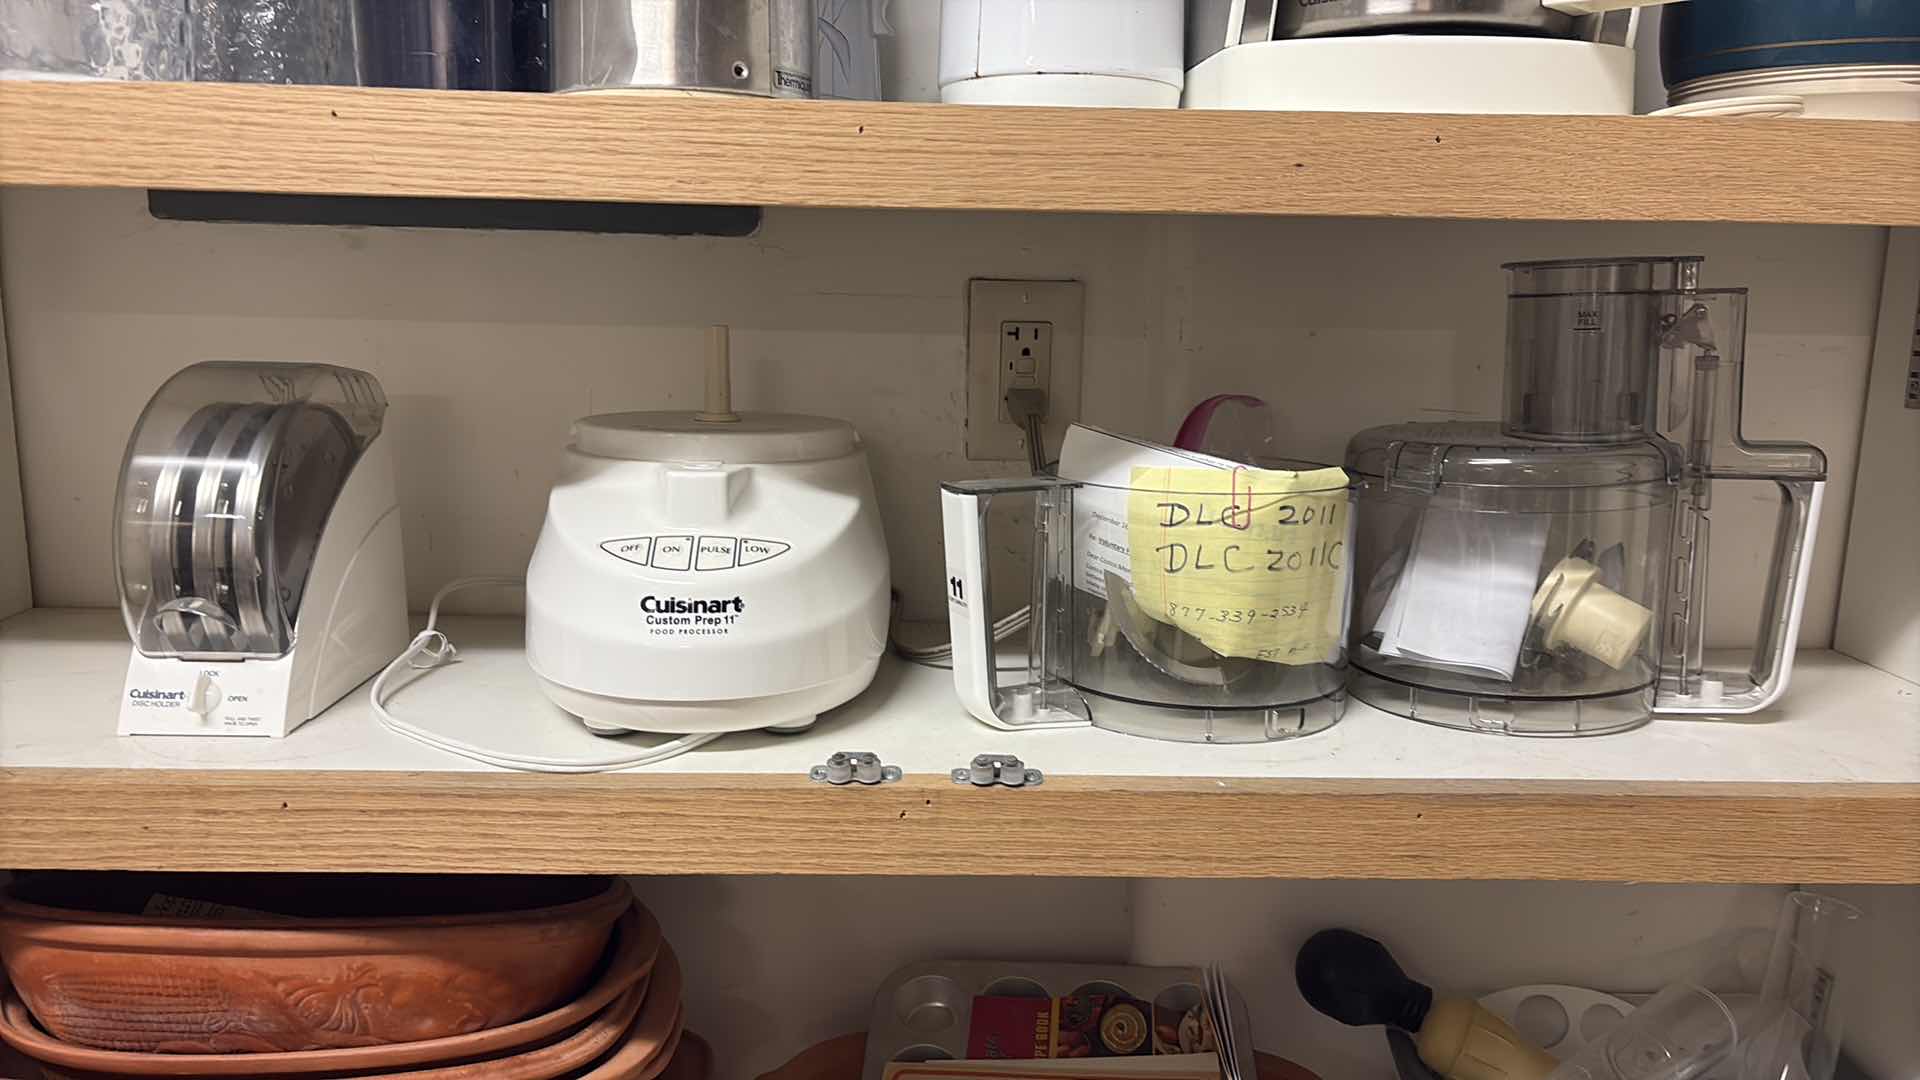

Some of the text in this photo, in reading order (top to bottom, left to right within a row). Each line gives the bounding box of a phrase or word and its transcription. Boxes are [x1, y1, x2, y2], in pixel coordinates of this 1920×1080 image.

[1578, 318, 1597, 326] FILL
[1156, 502, 1336, 529] DLC 2011
[620, 544, 641, 554] OFF
[662, 545, 681, 553] ON
[700, 545, 731, 554] PULSE
[745, 545, 770, 554] LOW
[1155, 540, 1343, 574] DLC 2011C
[950, 576, 963, 600] 11
[646, 615, 691, 625] Custom
[695, 615, 722, 627] Prep
[130, 688, 185, 700] Cuisinart
[227, 695, 248, 703] OPEN
[131, 700, 181, 709] DISC HOLDER
[1035, 1011, 1049, 1041] BOOK
